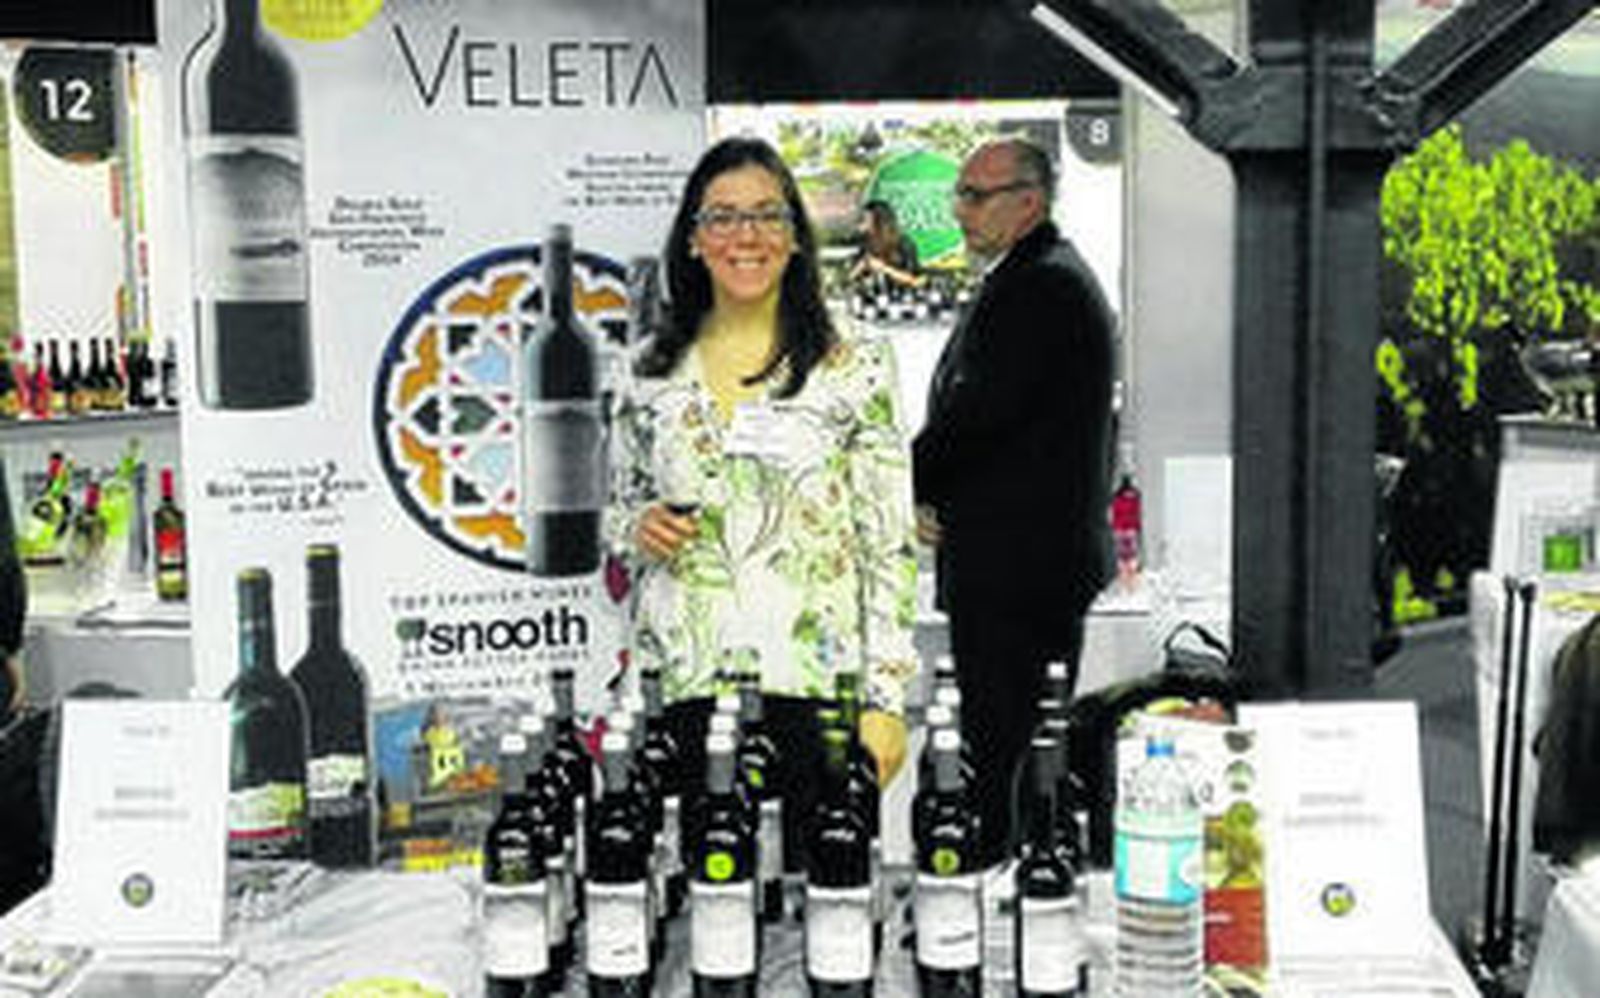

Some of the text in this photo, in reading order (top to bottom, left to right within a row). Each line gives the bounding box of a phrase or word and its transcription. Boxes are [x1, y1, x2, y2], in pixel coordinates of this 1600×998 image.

[393, 24, 679, 108] VELETA
[40, 79, 95, 122] 12
[1089, 116, 1110, 146] 8
[428, 604, 589, 656] snooth
